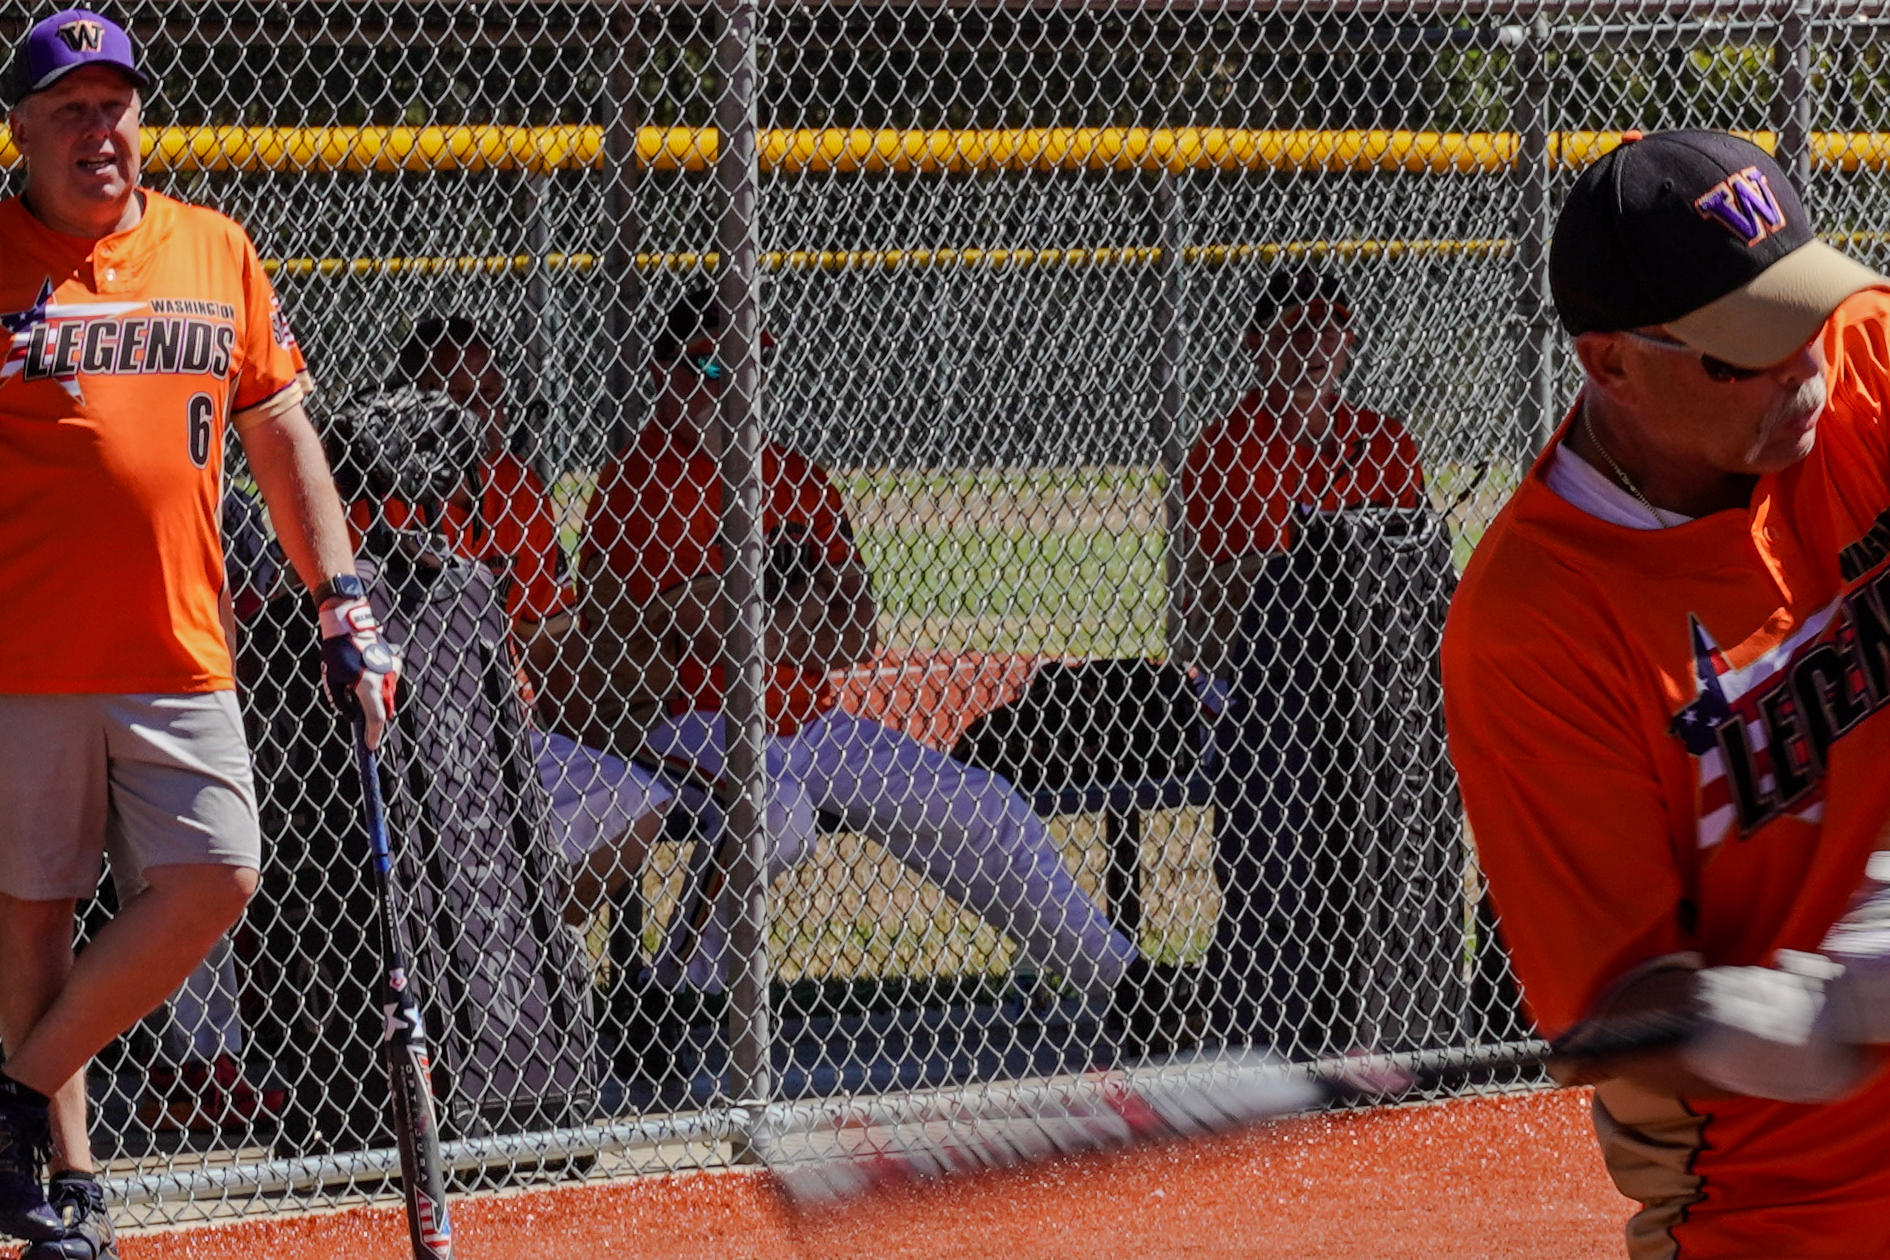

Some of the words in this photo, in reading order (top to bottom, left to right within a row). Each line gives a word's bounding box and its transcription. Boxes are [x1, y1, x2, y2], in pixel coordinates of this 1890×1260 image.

[57, 20, 105, 53] W
[1694, 166, 1787, 247] W
[149, 298, 236, 321] WASHINGTON
[23, 317, 236, 382] LEGENDS
[187, 392, 214, 470] 6
